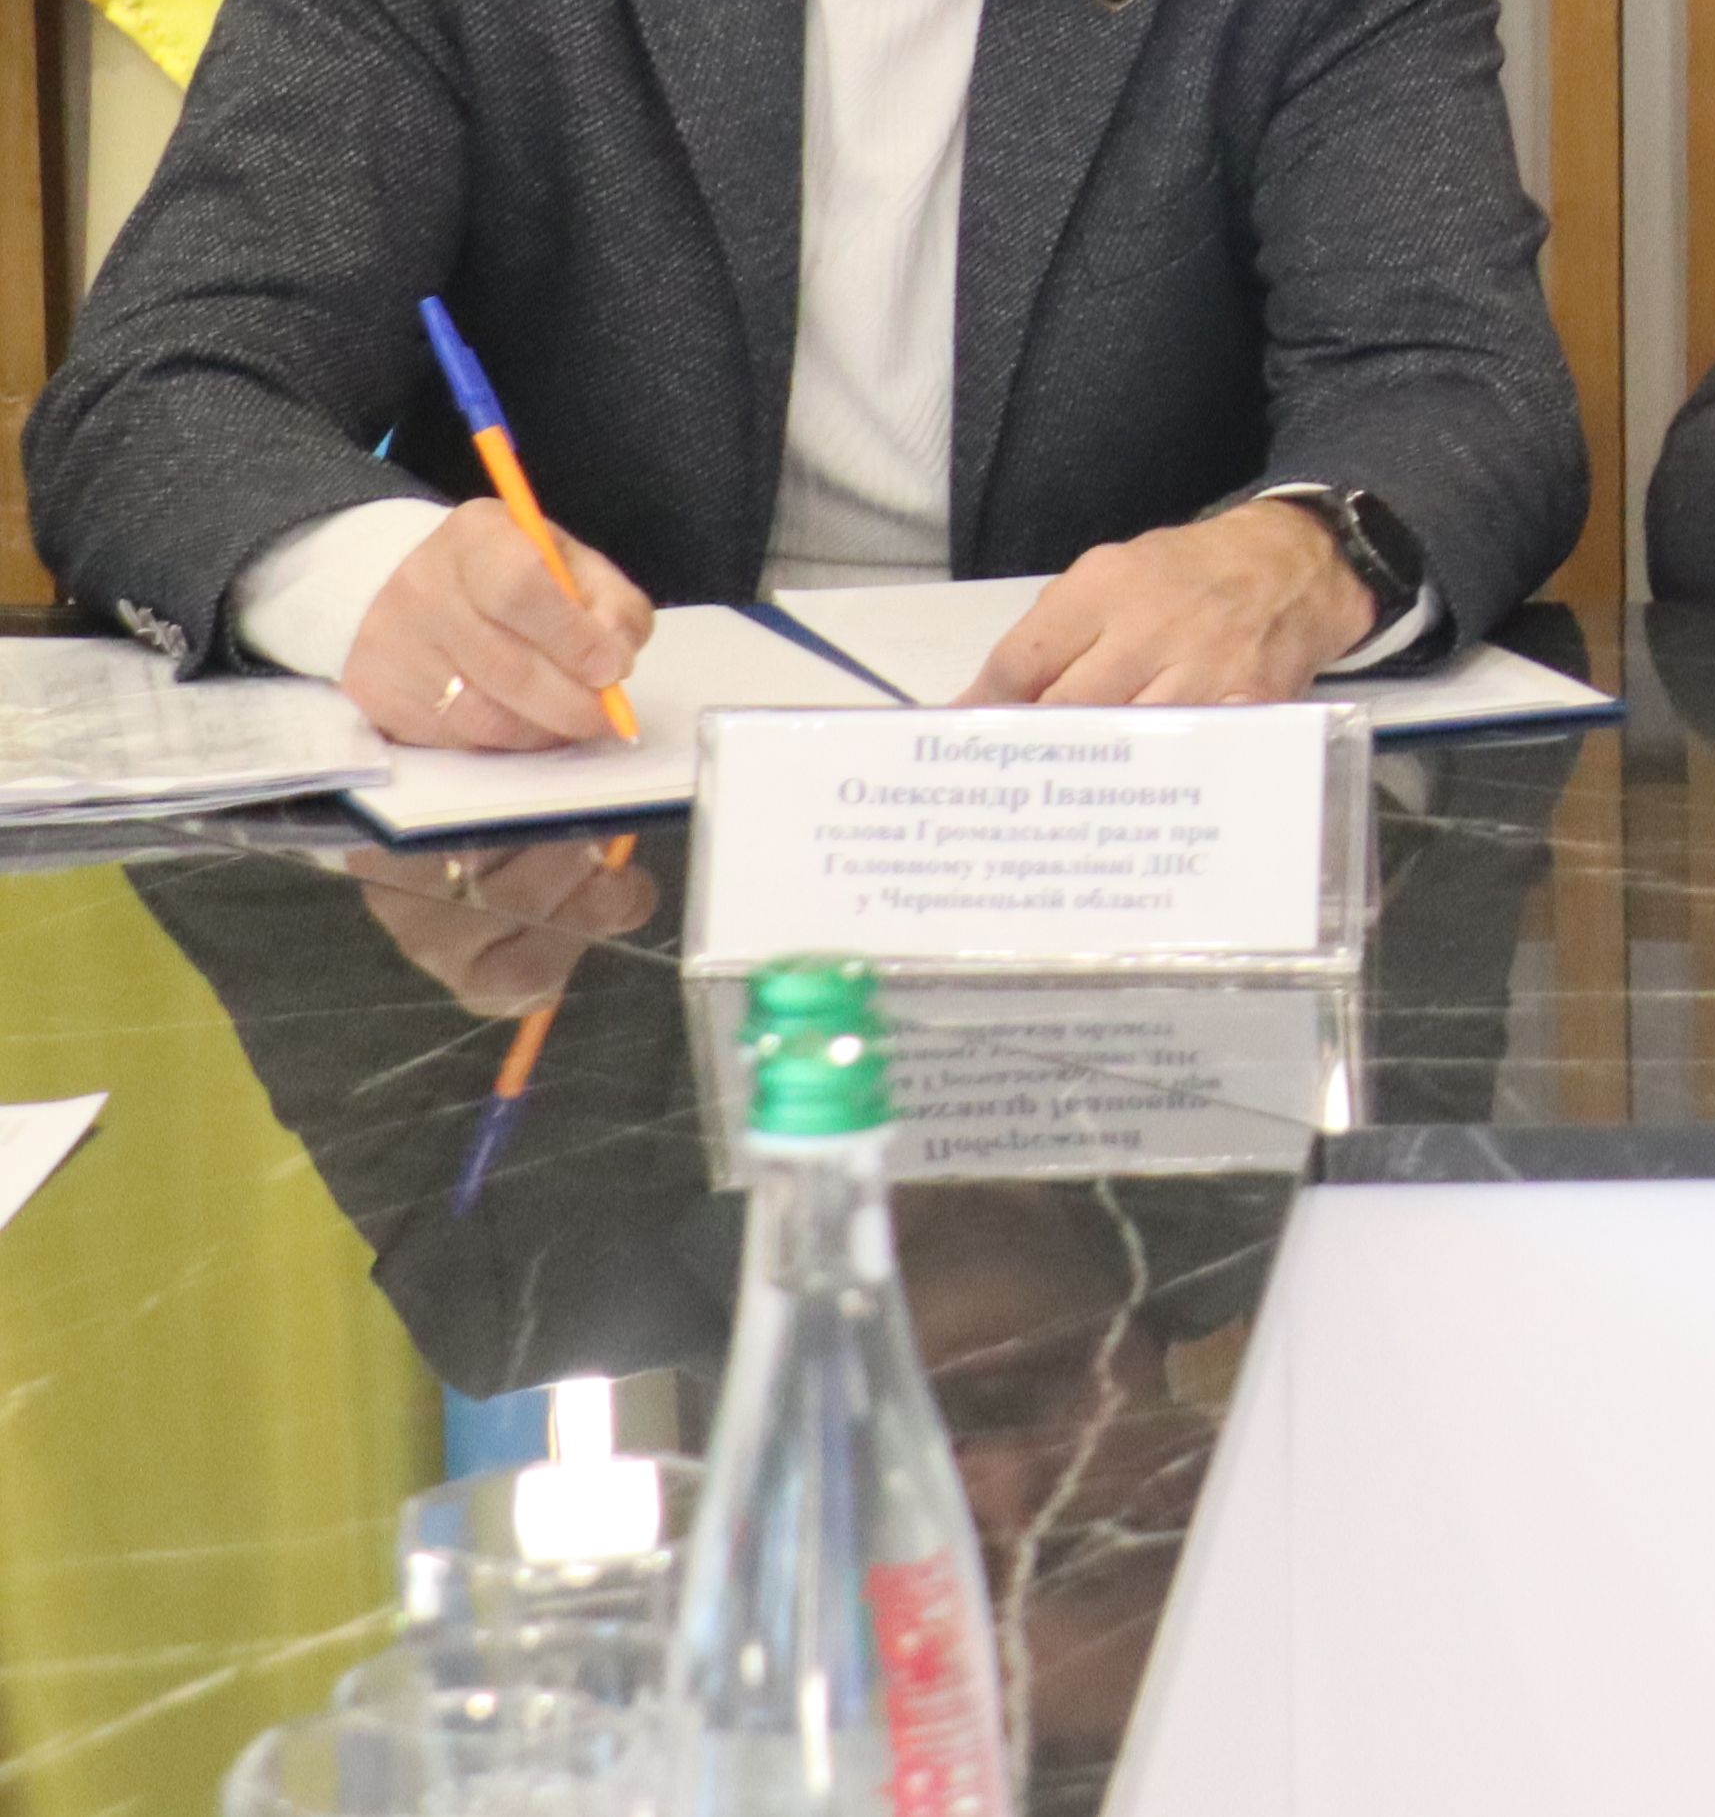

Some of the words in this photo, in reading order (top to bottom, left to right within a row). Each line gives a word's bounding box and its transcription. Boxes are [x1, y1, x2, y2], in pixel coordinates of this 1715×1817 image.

[914, 735, 1132, 771] Побережний
[837, 778, 1031, 814] Олександр
[1042, 779, 1201, 807] Іванович
[814, 824, 907, 842] голова
[916, 818, 1093, 846] Громадської
[1097, 824, 1164, 847] ради
[1170, 826, 1220, 848] при
[824, 853, 974, 880] Головному
[984, 855, 1134, 881] управлінні
[1141, 851, 1208, 879] ДПС
[855, 893, 870, 915] у
[880, 887, 1065, 915] Чернівецькій
[1073, 887, 1173, 911] області
